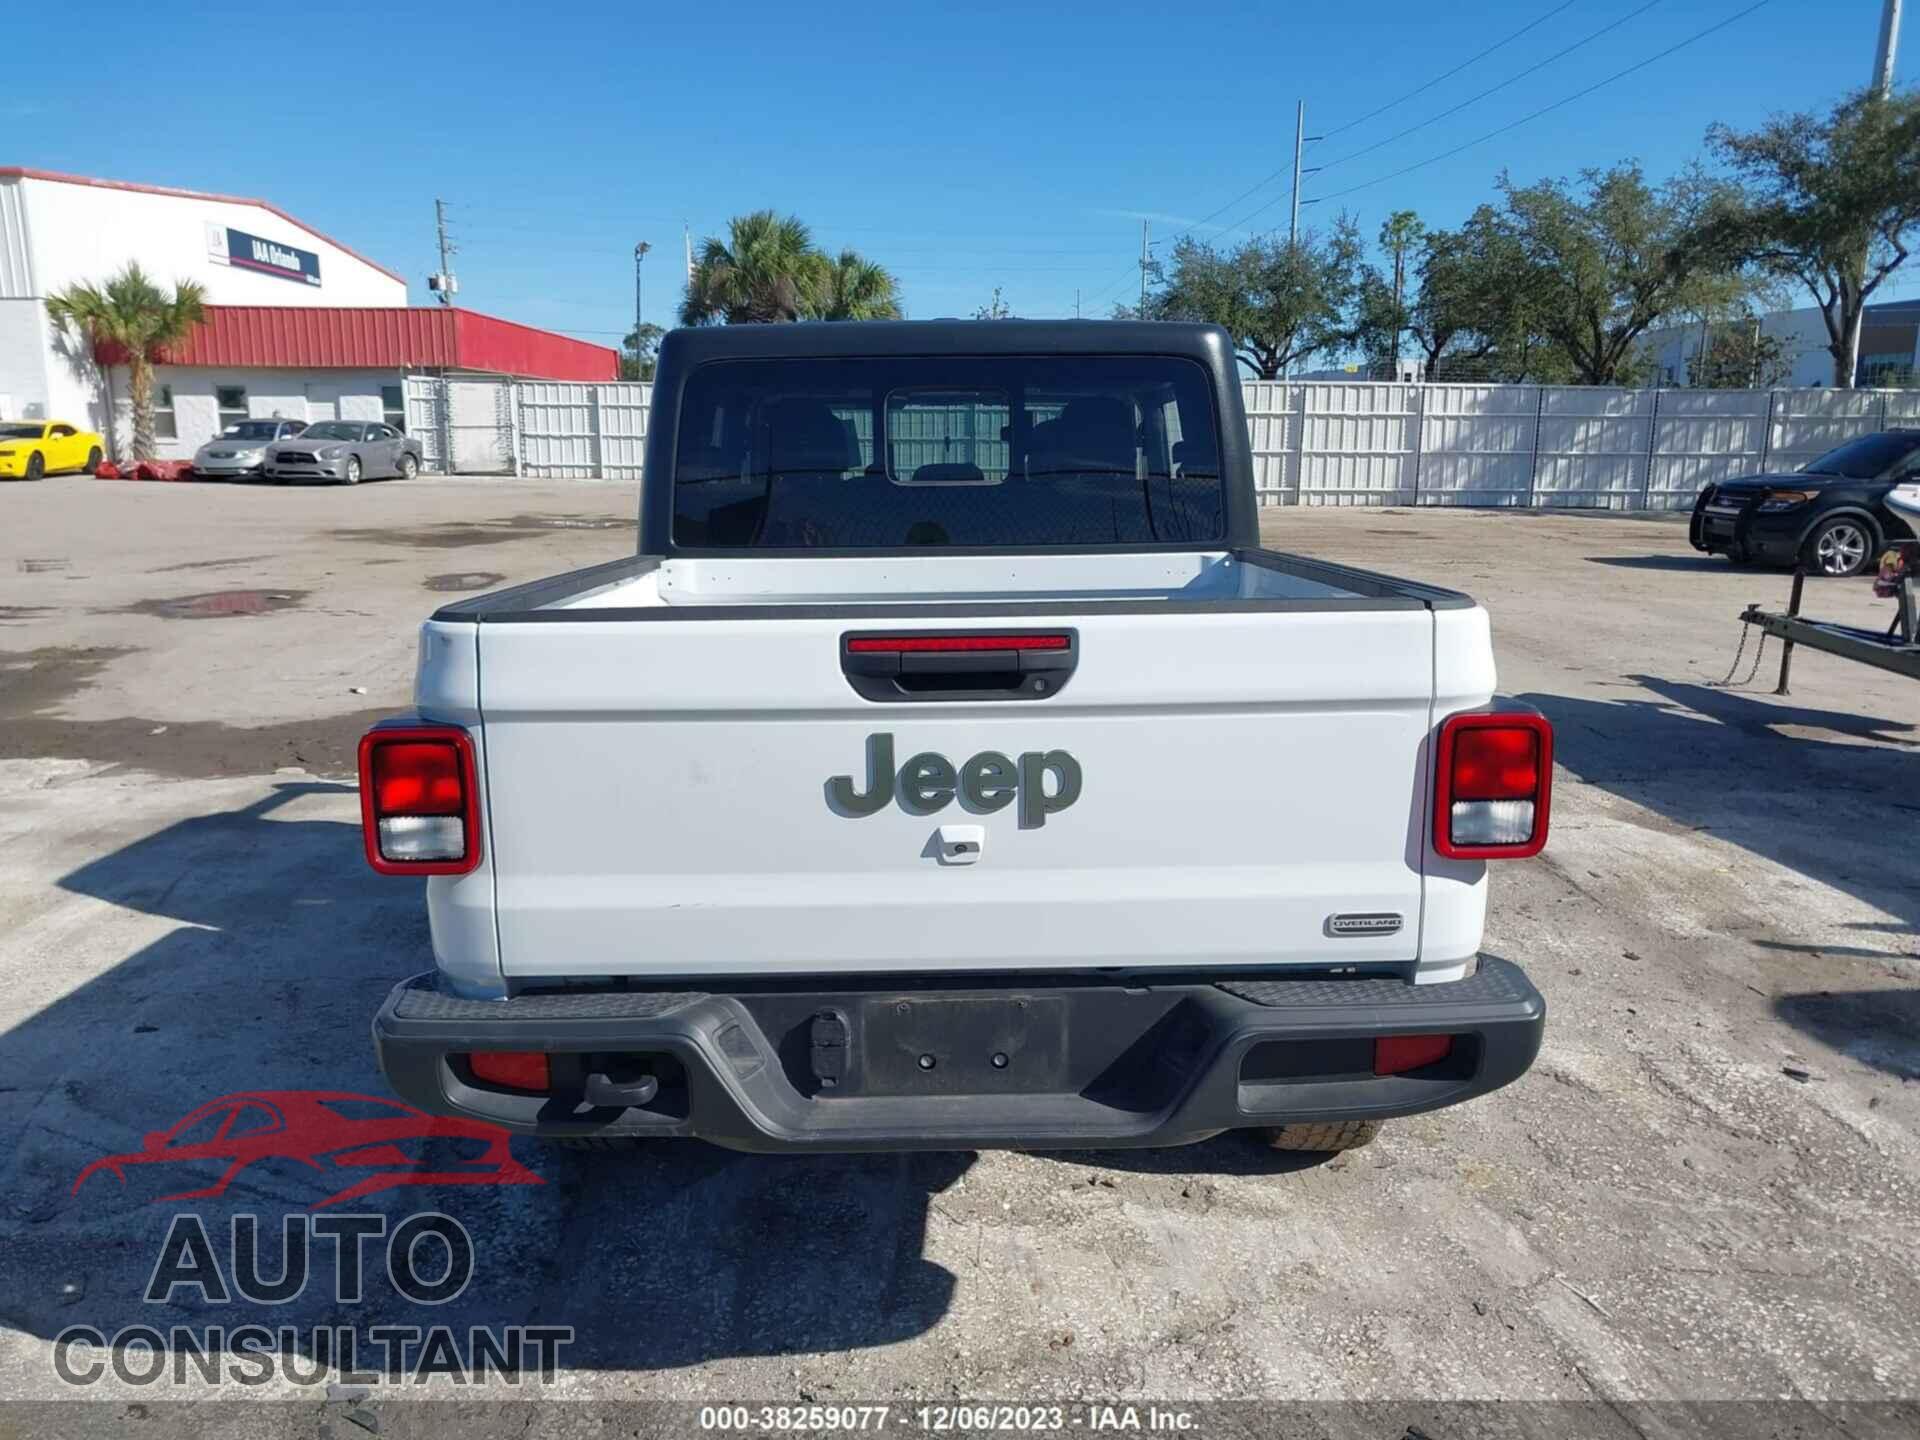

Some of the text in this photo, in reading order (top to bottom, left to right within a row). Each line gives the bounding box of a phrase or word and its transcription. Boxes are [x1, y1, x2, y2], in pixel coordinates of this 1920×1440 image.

[252, 239, 301, 271] IAA Orlando
[823, 732, 1083, 830] Jeep
[1333, 919, 1402, 928] OVERLAND
